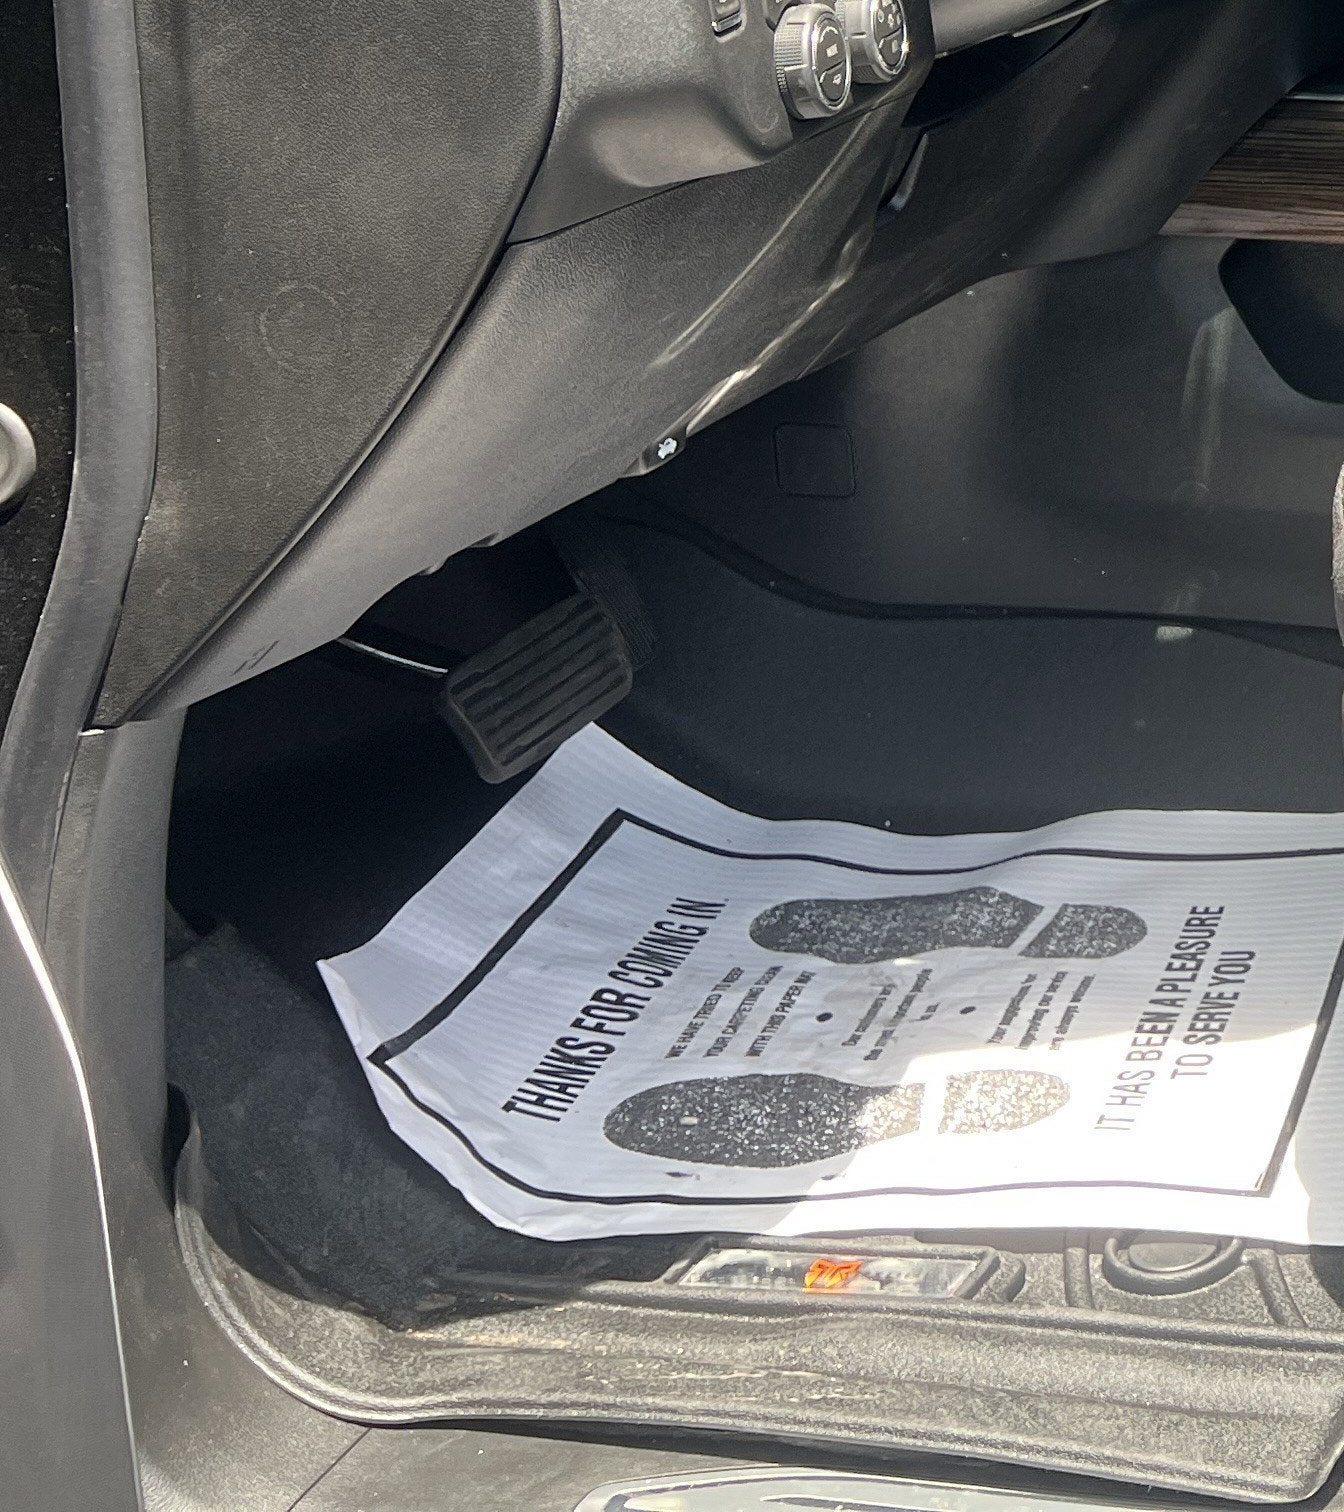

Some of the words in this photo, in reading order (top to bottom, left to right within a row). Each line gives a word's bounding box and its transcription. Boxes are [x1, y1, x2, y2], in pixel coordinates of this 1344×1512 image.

[604, 919, 710, 990] COMING
[1153, 904, 1227, 995] PLEASURE
[1207, 948, 1257, 986] YOU
[568, 986, 653, 1037] FOR
[674, 1020, 705, 1043] HAVE
[692, 992, 724, 1019] TRIED
[773, 984, 805, 1013] PAPER
[1182, 990, 1242, 1047] SERVE
[743, 1033, 773, 1057] WITH
[760, 1013, 787, 1033] THIS
[1123, 1010, 1180, 1062] BEEN
[500, 1034, 619, 1123] THANKS
[1103, 1067, 1156, 1108] HAS
[1168, 1051, 1215, 1079] TO
[1092, 1114, 1136, 1132] IT
